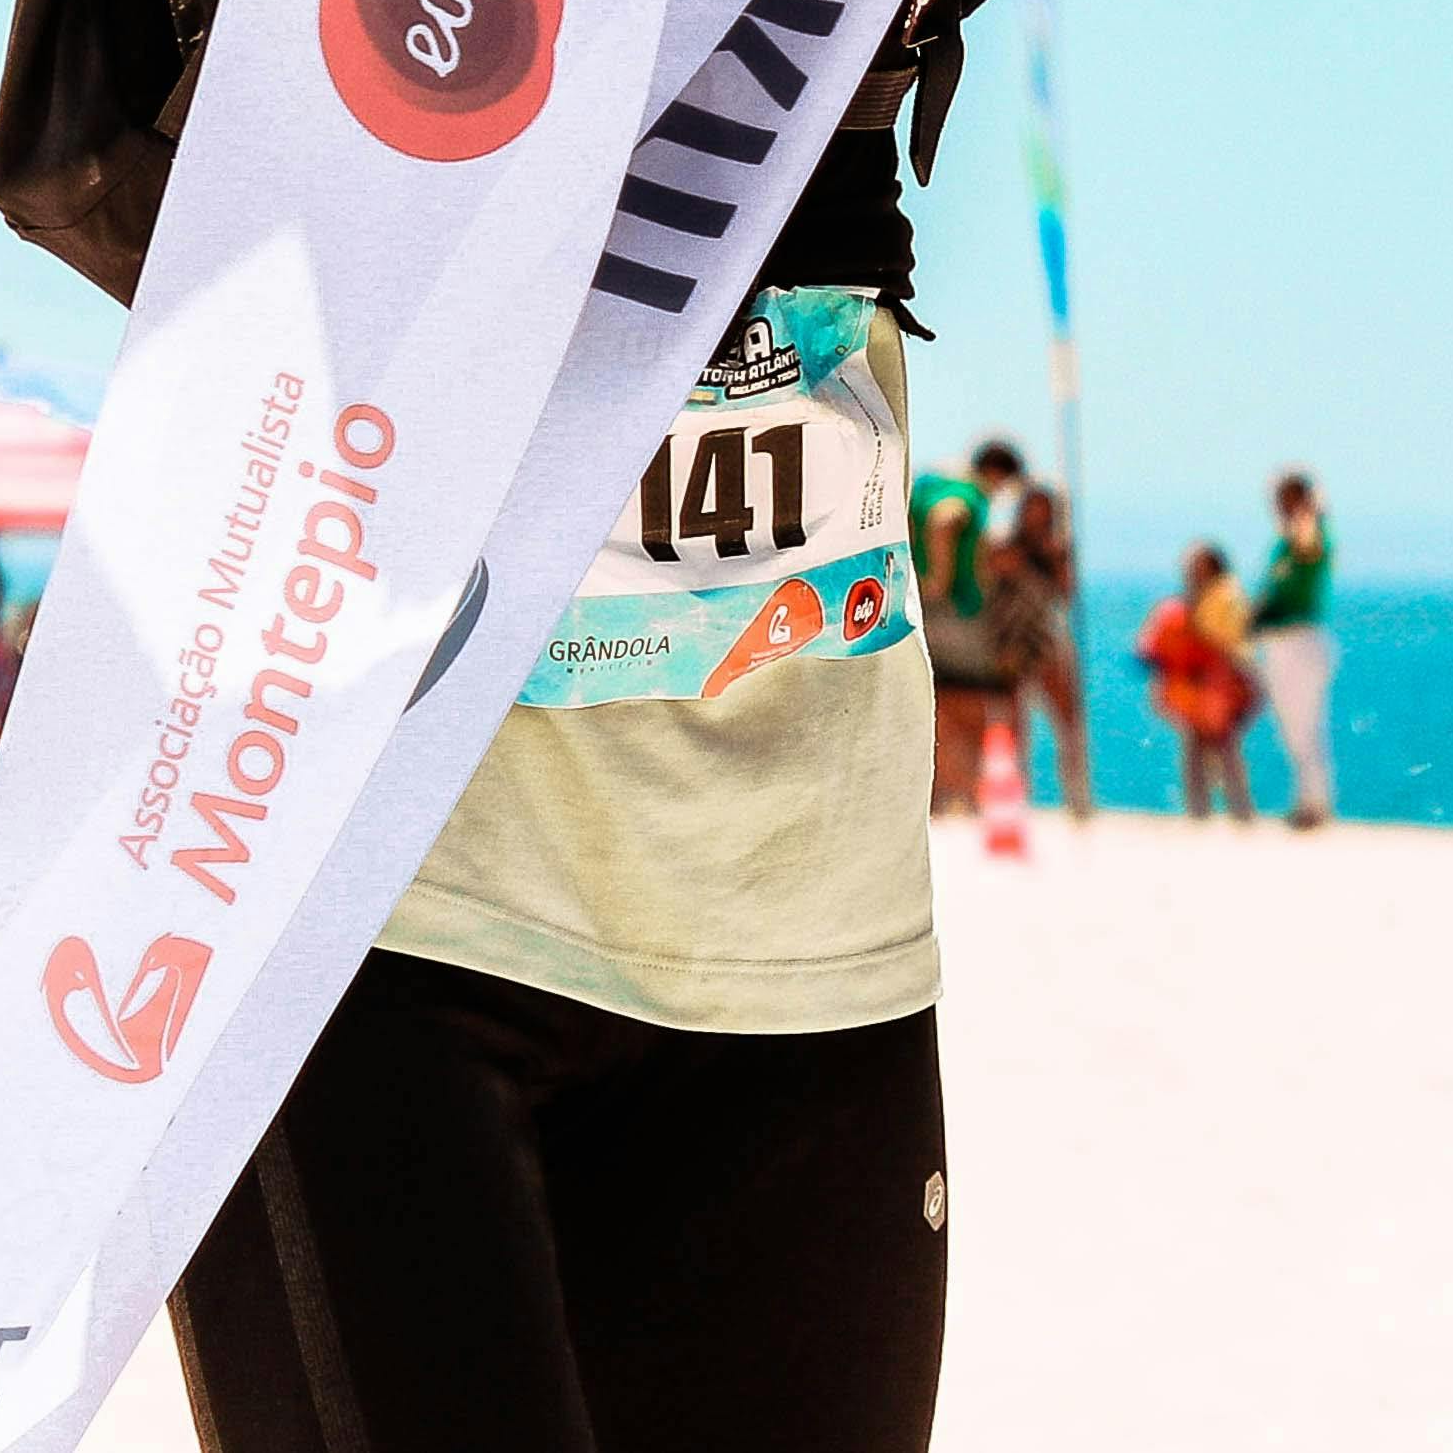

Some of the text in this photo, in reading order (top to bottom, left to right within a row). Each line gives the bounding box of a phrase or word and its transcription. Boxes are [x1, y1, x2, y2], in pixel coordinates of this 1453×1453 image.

[118, 371, 306, 870] Associação Mutualista
[171, 403, 397, 906] Montepio
[549, 635, 670, 663] GRÂNDOLA
[854, 597, 875, 624] edp
